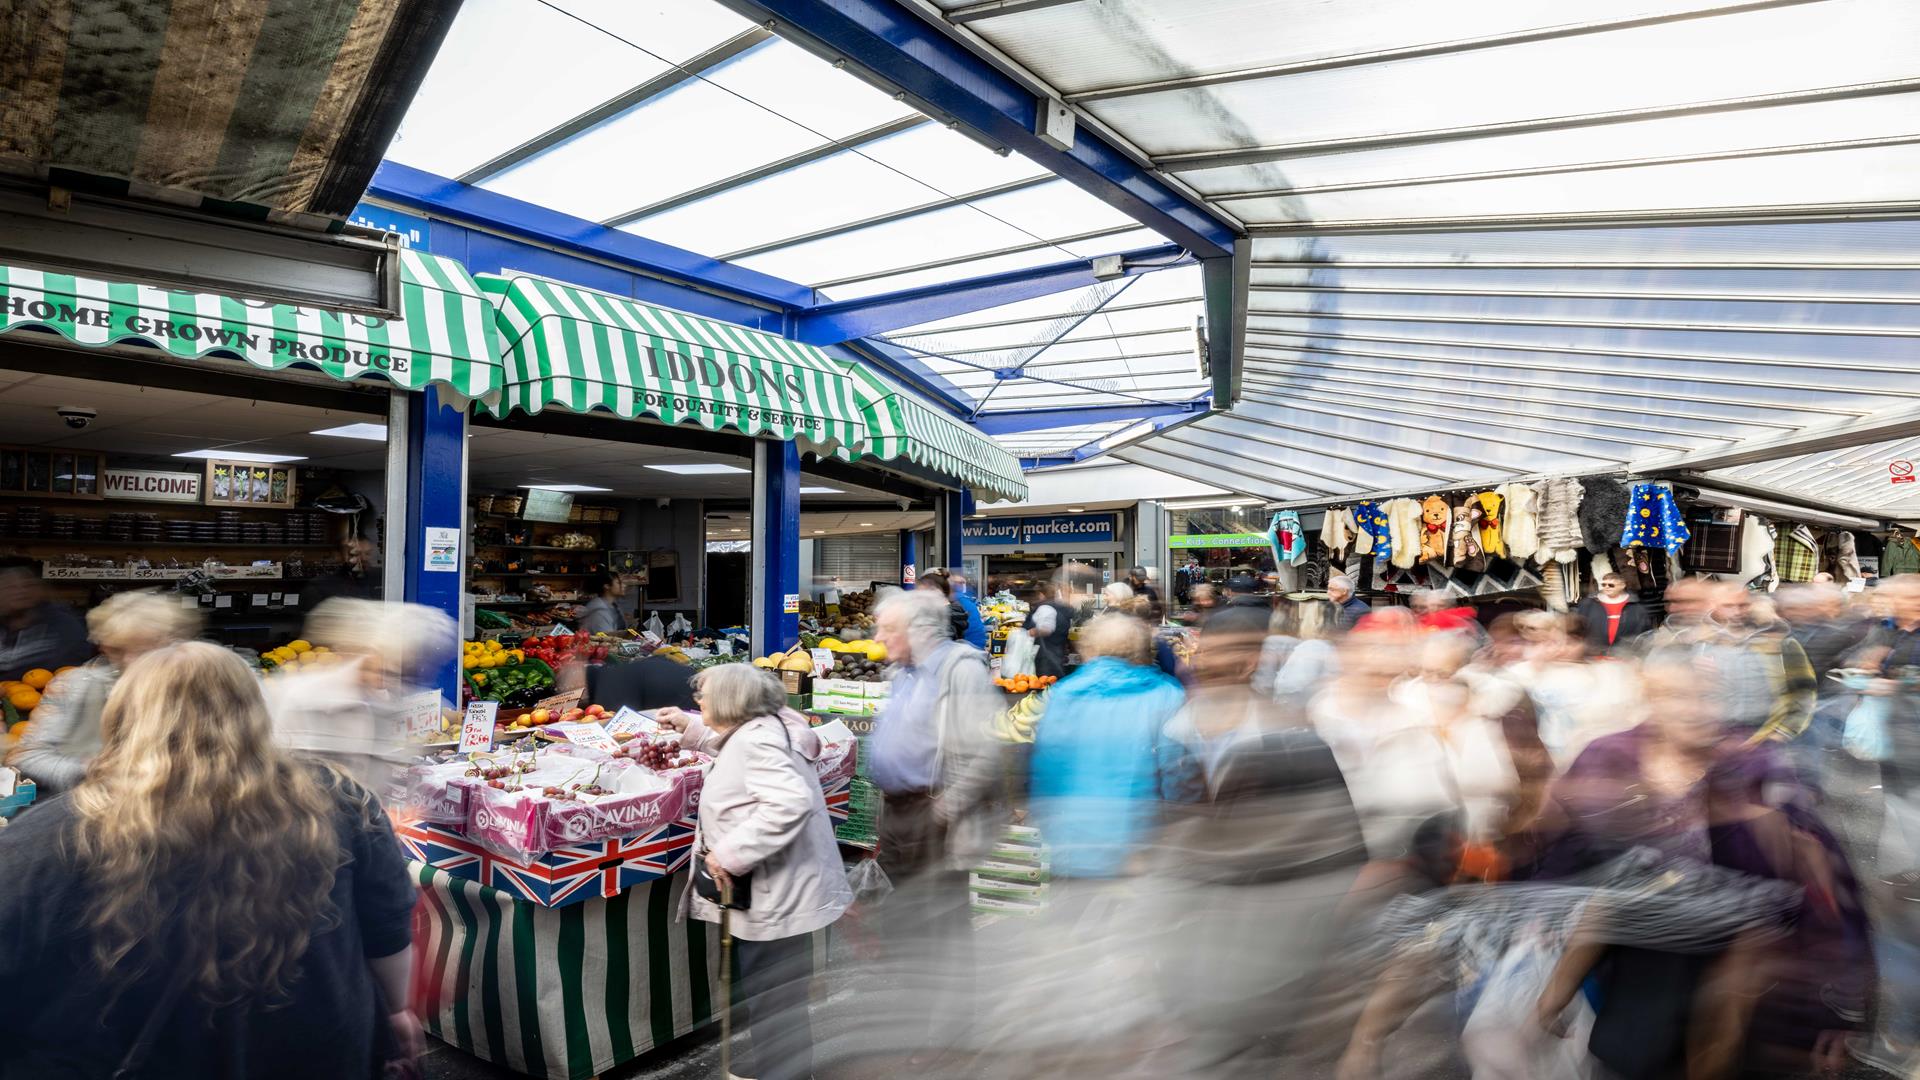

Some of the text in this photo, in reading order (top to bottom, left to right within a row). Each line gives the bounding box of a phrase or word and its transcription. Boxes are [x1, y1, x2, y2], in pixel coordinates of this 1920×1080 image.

[0, 295, 113, 329] HOME
[125, 315, 260, 351] GROWN
[269, 336, 409, 373] PRODUCE
[642, 345, 805, 404] IDDONS
[633, 391, 822, 431] FOR QUALITY & SERVICE
[104, 474, 196, 495] WELCOME
[593, 801, 660, 829] LAVINIA
